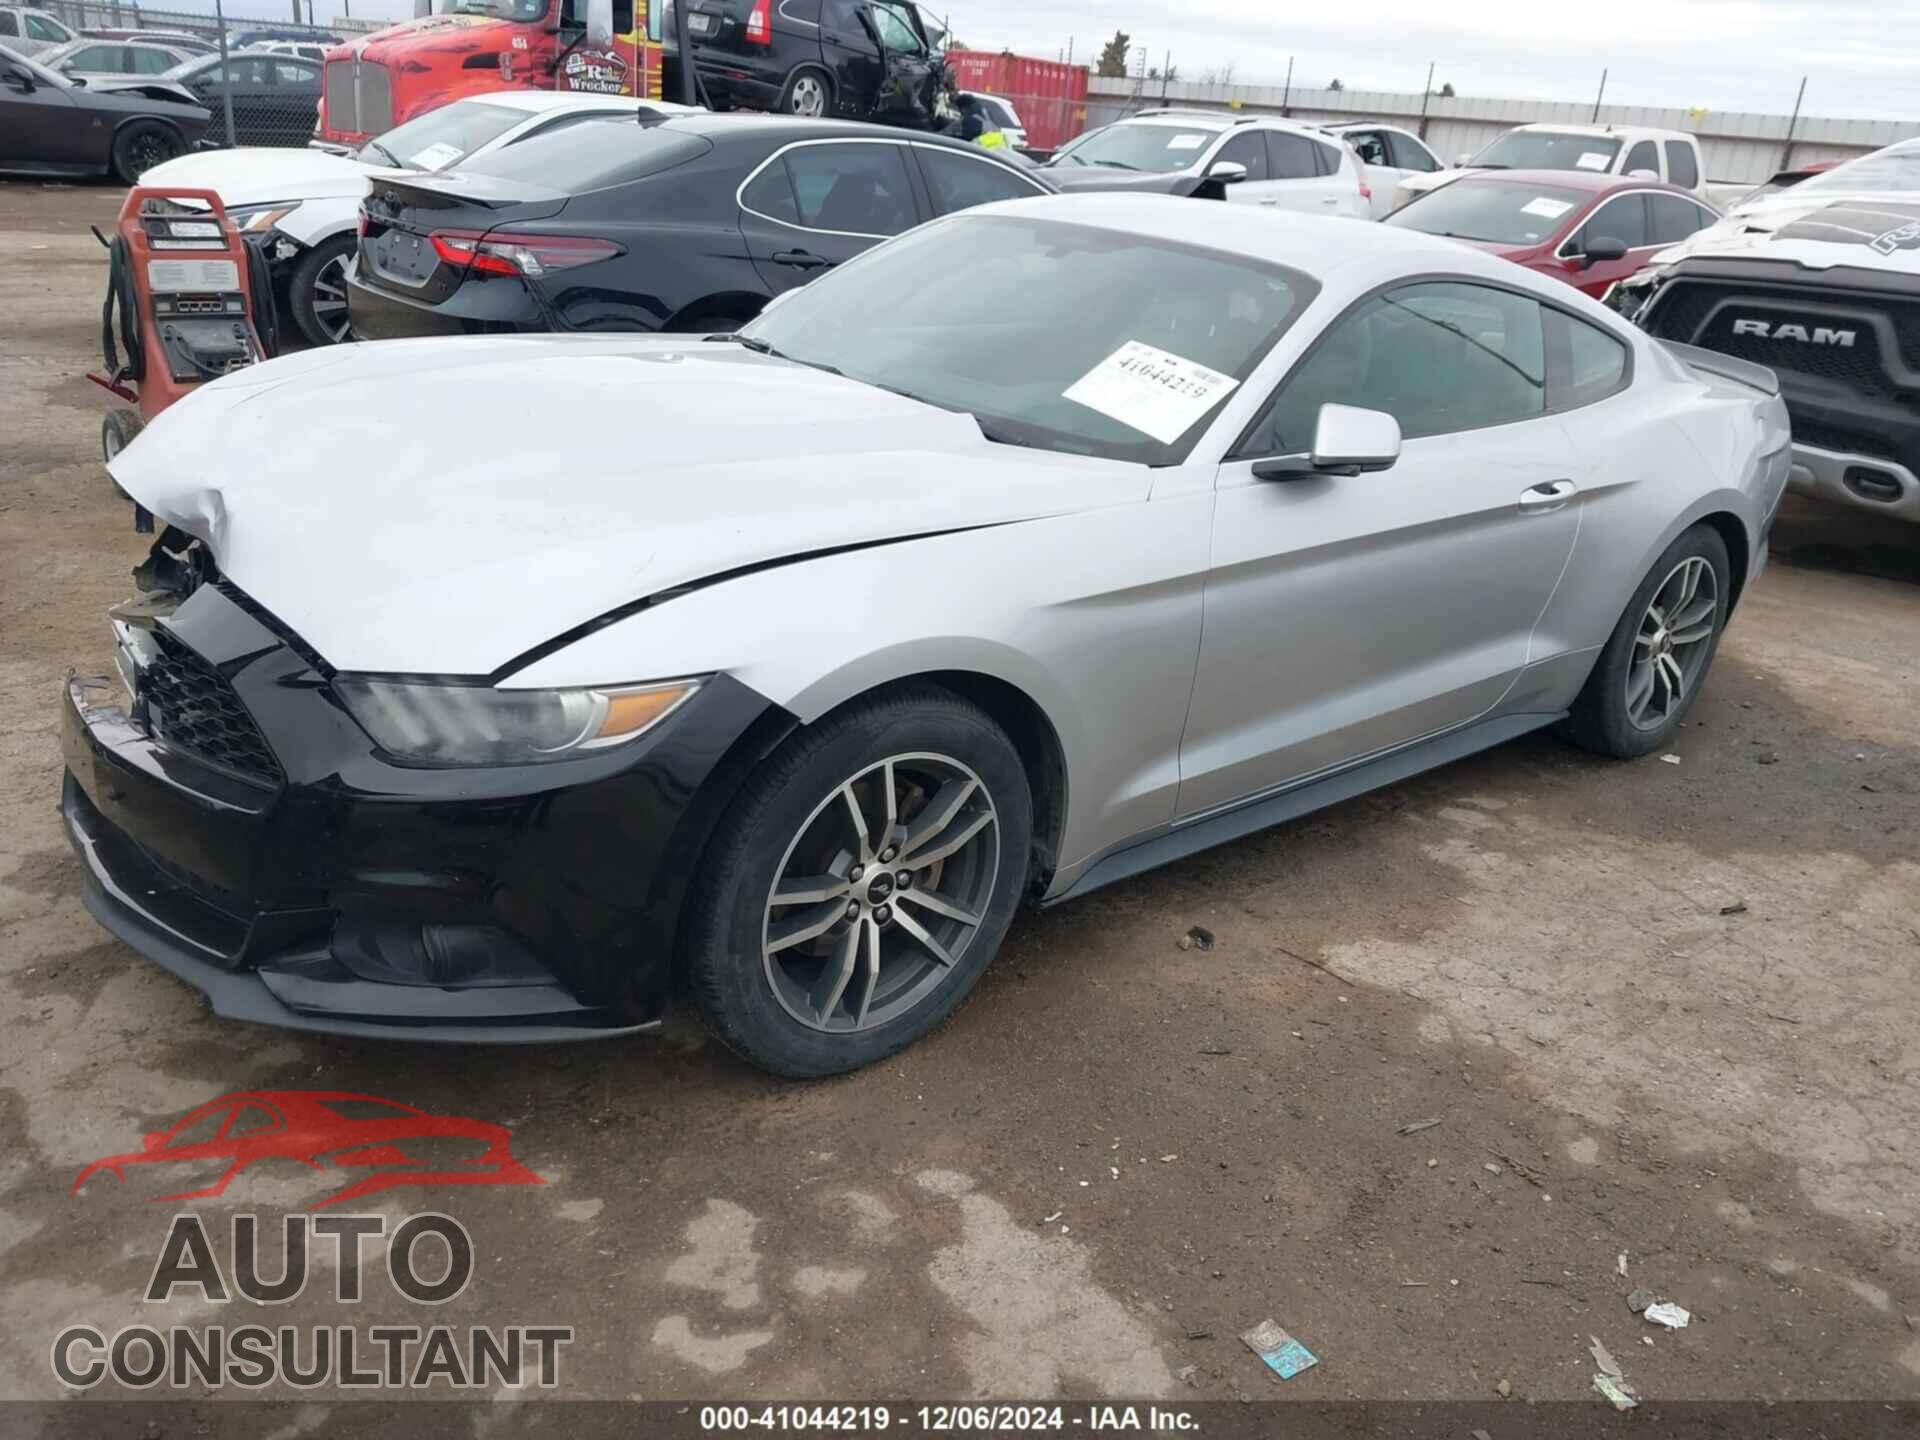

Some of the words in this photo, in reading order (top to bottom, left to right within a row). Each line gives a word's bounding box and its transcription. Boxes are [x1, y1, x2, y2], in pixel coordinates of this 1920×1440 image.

[568, 78, 621, 94] Wrecker
[1732, 319, 1857, 347] RAM
[1119, 358, 1207, 398] 41044219
